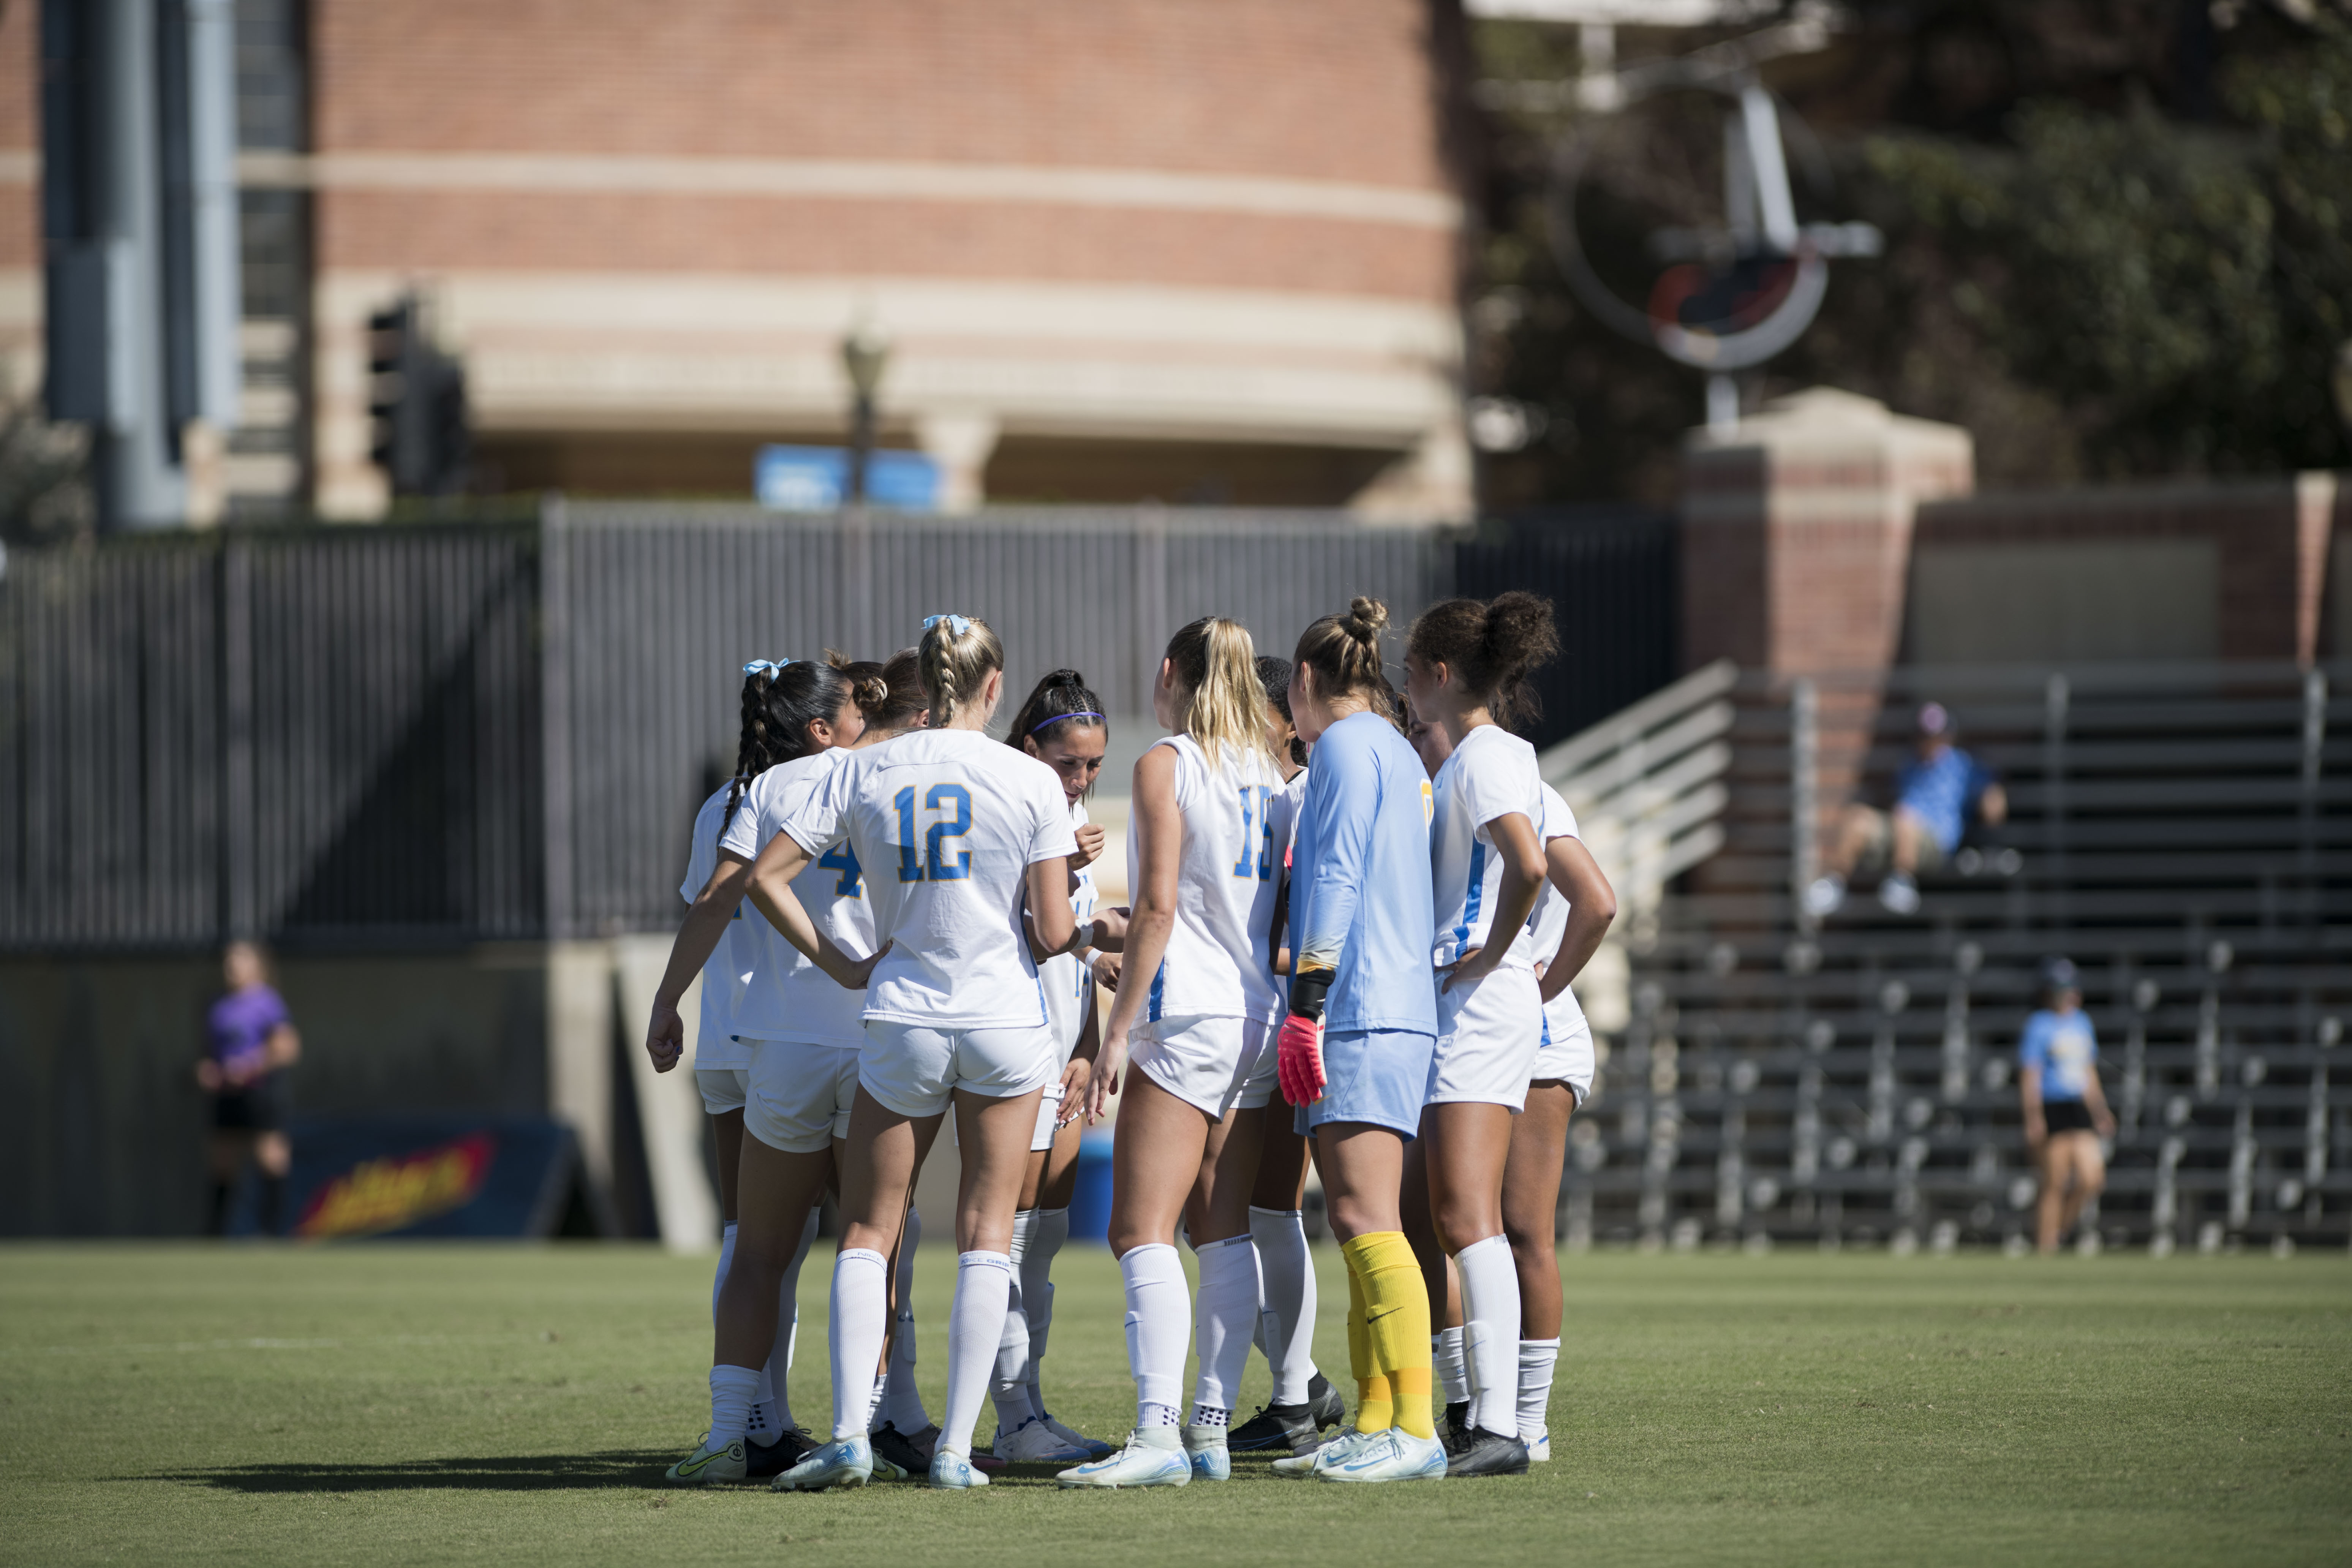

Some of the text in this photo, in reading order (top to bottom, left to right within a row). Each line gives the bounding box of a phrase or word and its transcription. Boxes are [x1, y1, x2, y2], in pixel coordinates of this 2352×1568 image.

[817, 836, 863, 900] 4
[893, 782, 973, 883] 12
[1232, 783, 1274, 882] 15
[986, 1258, 1009, 1267] GRIP
